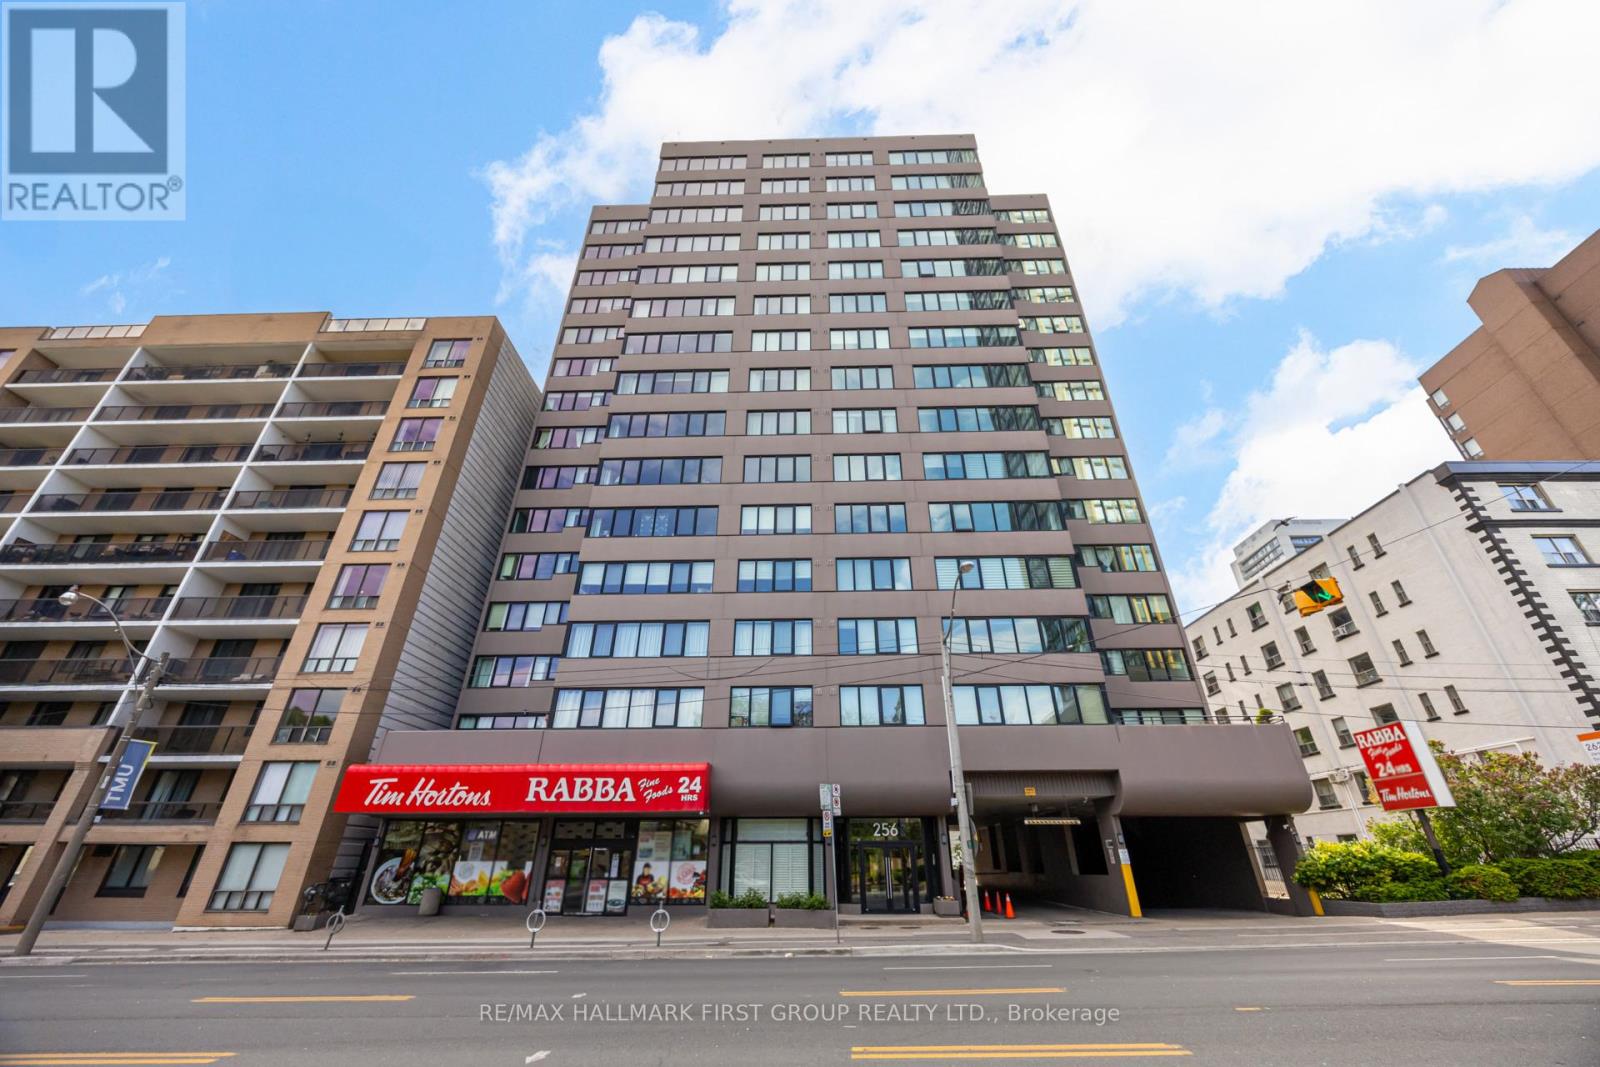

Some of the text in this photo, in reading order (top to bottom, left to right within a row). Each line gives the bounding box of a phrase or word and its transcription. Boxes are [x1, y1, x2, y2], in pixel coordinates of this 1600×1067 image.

[1355, 726, 1406, 749] RABBA
[1585, 742, 1600, 751] 26
[1375, 761, 1396, 777] 24
[104, 764, 134, 804] TMU
[364, 777, 491, 806] Tim Hortons
[525, 777, 637, 802] RABBA
[638, 777, 661, 791] Fine
[677, 776, 702, 793] 24
[643, 785, 673, 803] Foods
[1380, 788, 1398, 802] Tim
[477, 830, 497, 839] ATM
[873, 822, 899, 837] 256
